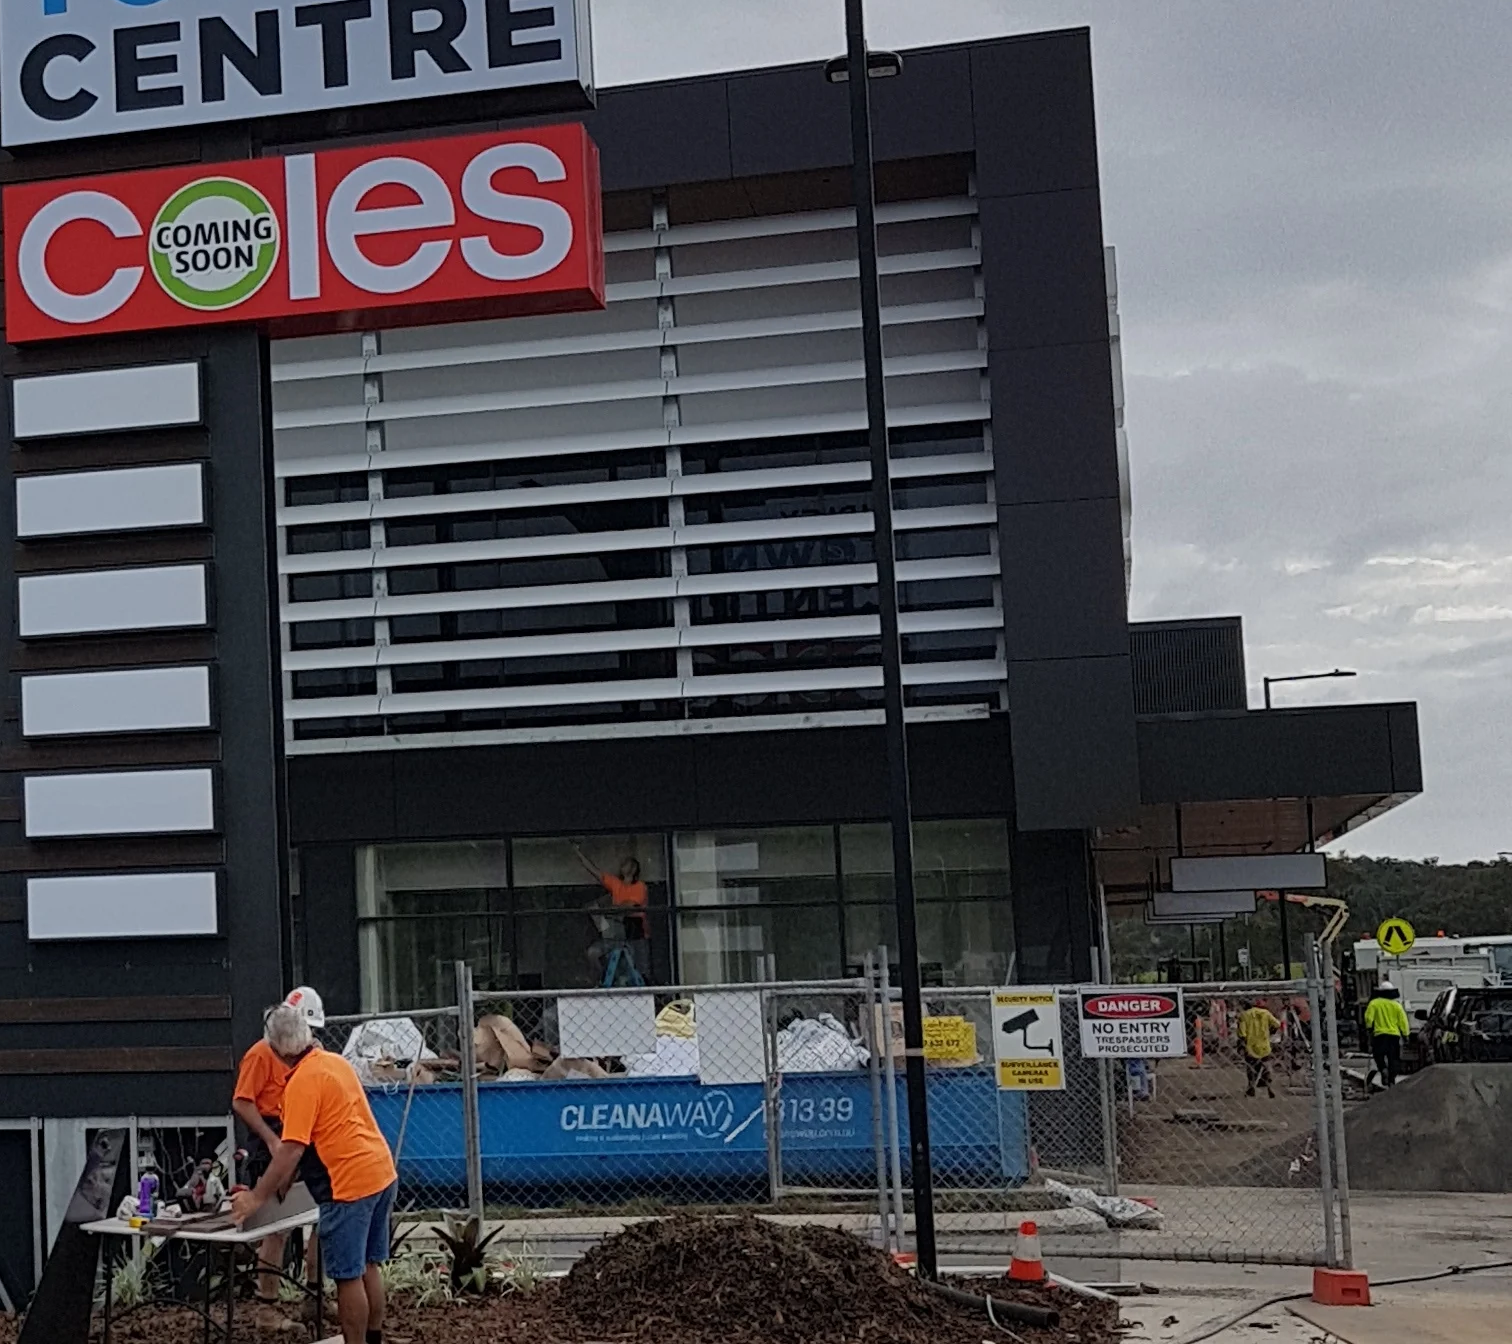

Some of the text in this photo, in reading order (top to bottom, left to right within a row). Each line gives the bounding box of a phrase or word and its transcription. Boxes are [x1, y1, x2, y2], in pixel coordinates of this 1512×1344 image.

[156, 216, 272, 249] COMING
[175, 244, 254, 274] SOON
[1097, 1000, 1161, 1012] DANGER
[1092, 1022, 1171, 1034] NO ENTRY
[1095, 1036, 1171, 1044] TRESPASSERS
[1098, 1045, 1169, 1053] PROSECUTED
[560, 1100, 725, 1131] CLEANAWAY
